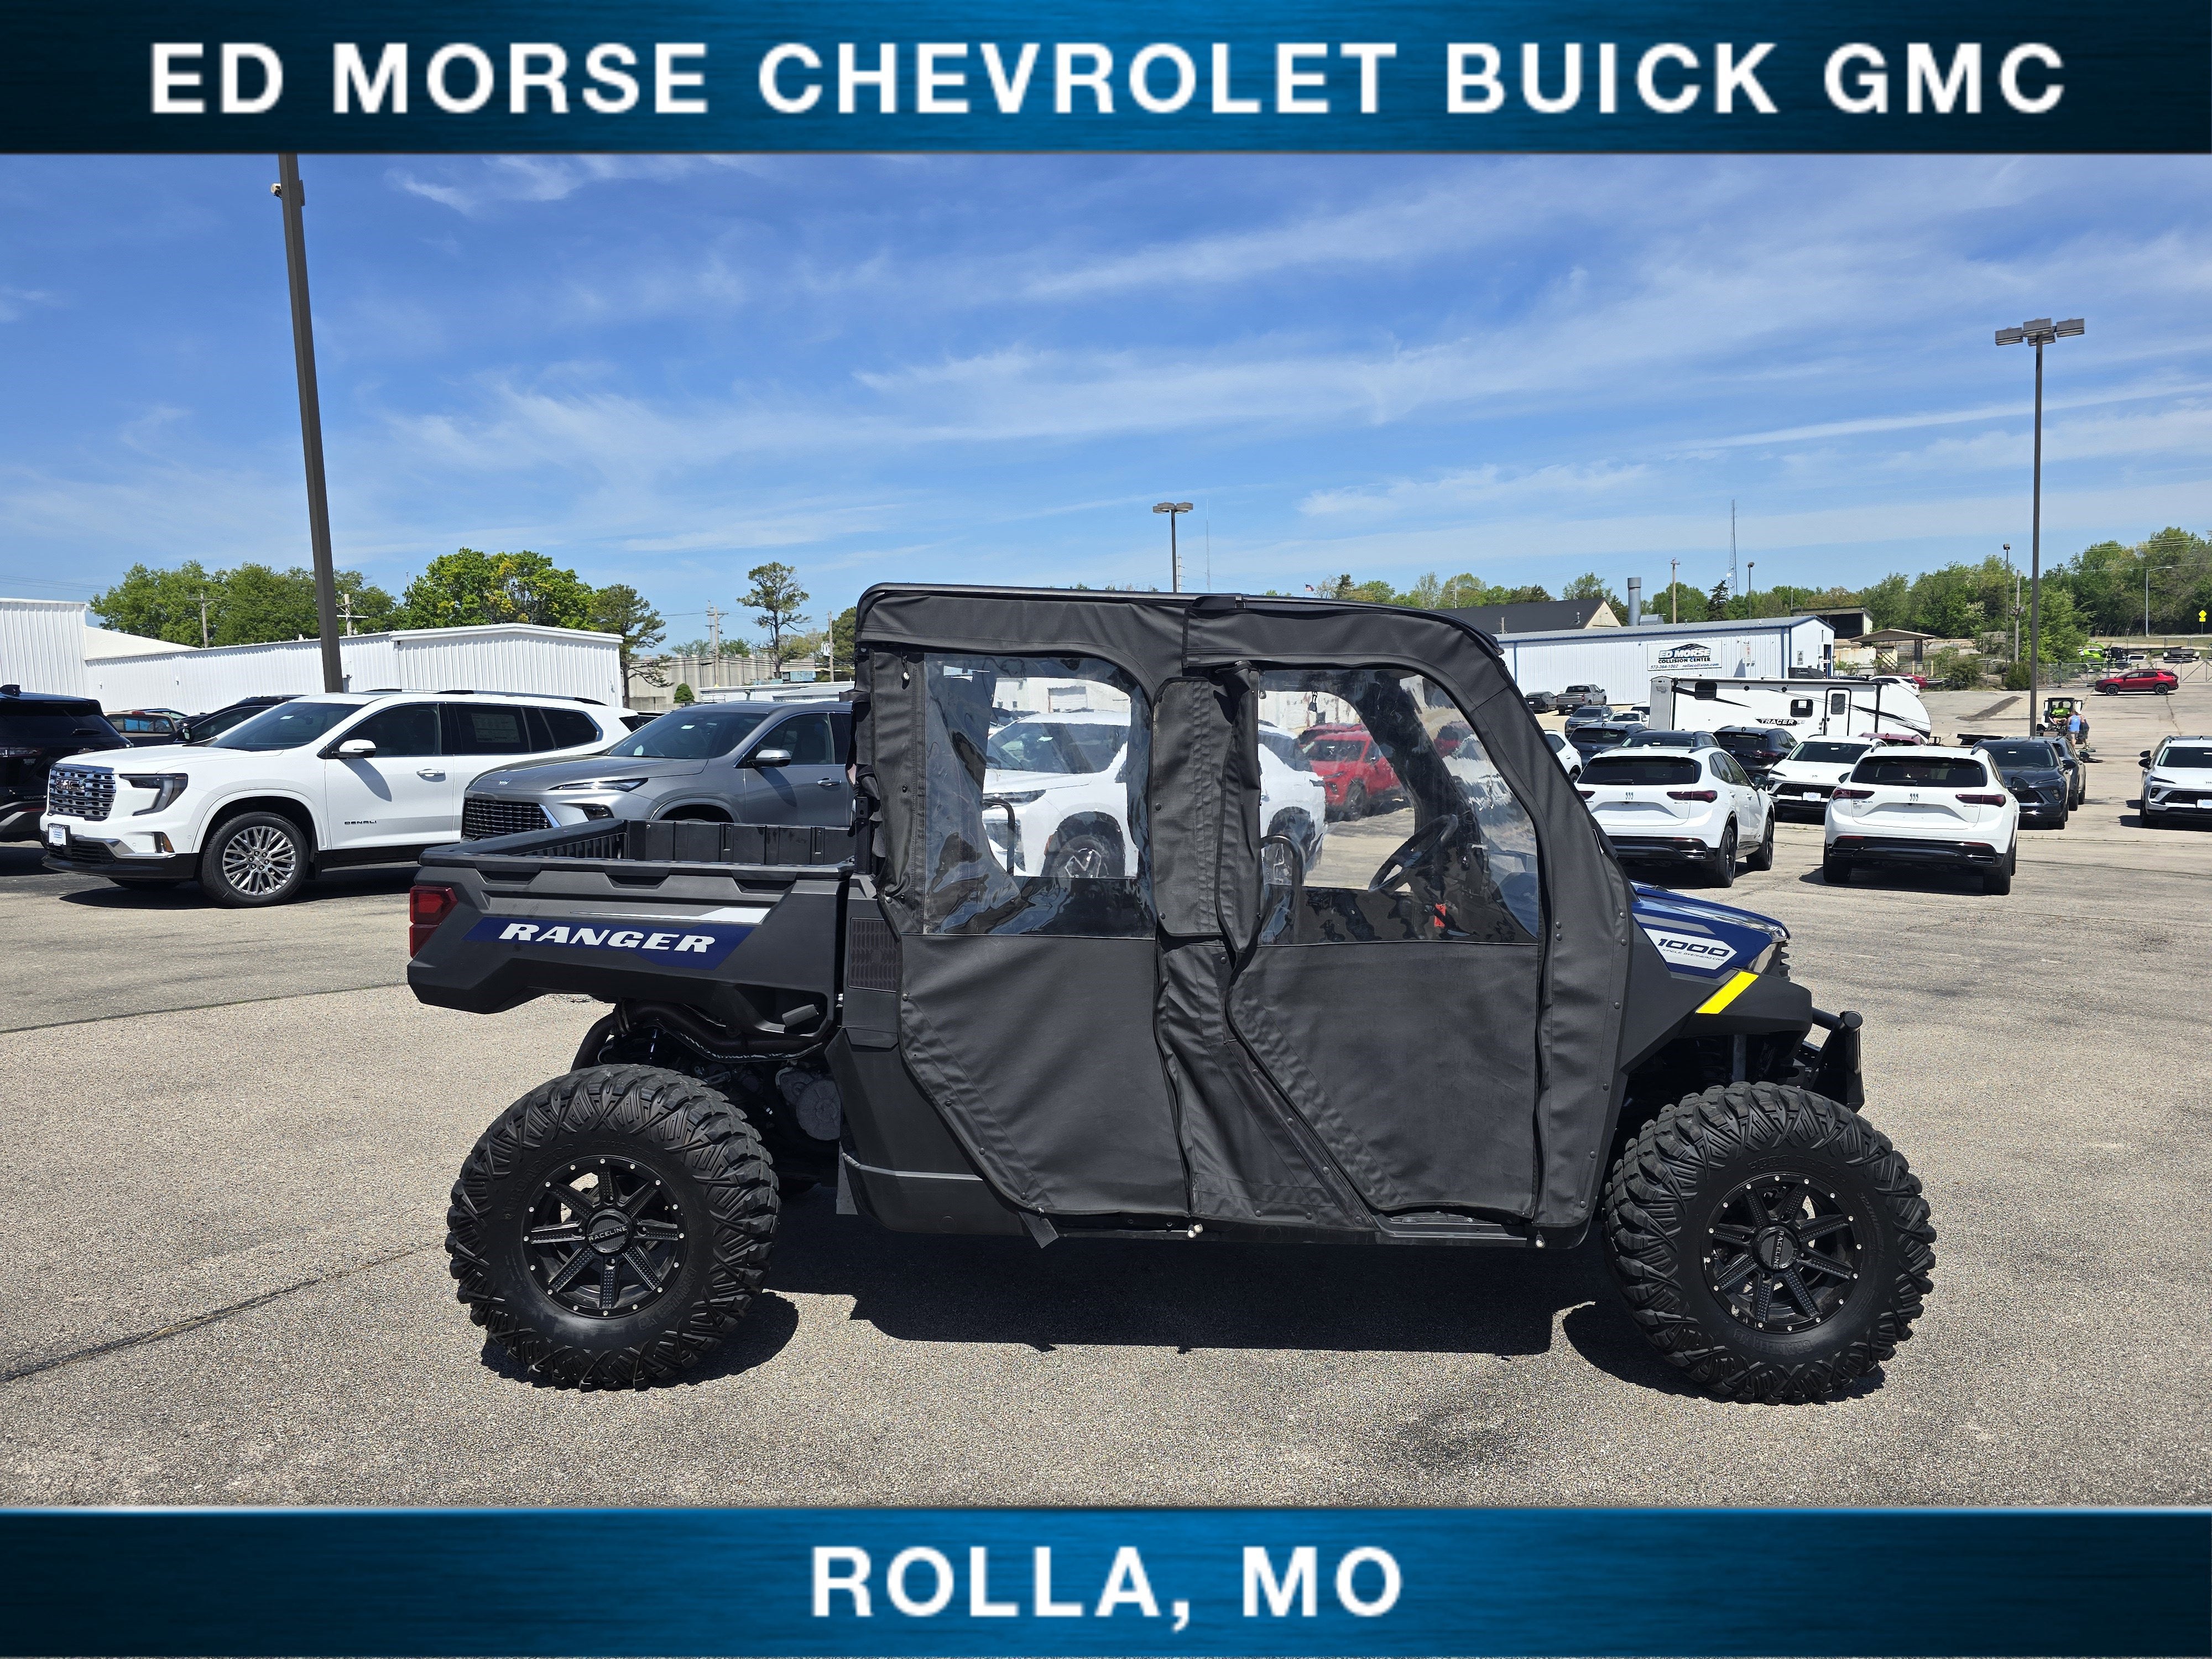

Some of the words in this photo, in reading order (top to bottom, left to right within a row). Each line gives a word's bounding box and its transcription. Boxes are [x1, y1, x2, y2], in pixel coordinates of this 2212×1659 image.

[1658, 650, 1673, 659] ED
[1673, 648, 1711, 658] MORSE
[498, 923, 716, 953] RANGER
[1658, 938, 1730, 957] 1000
[588, 1225, 628, 1242] RACELINE
[1772, 1229, 1785, 1270] RACELINE
